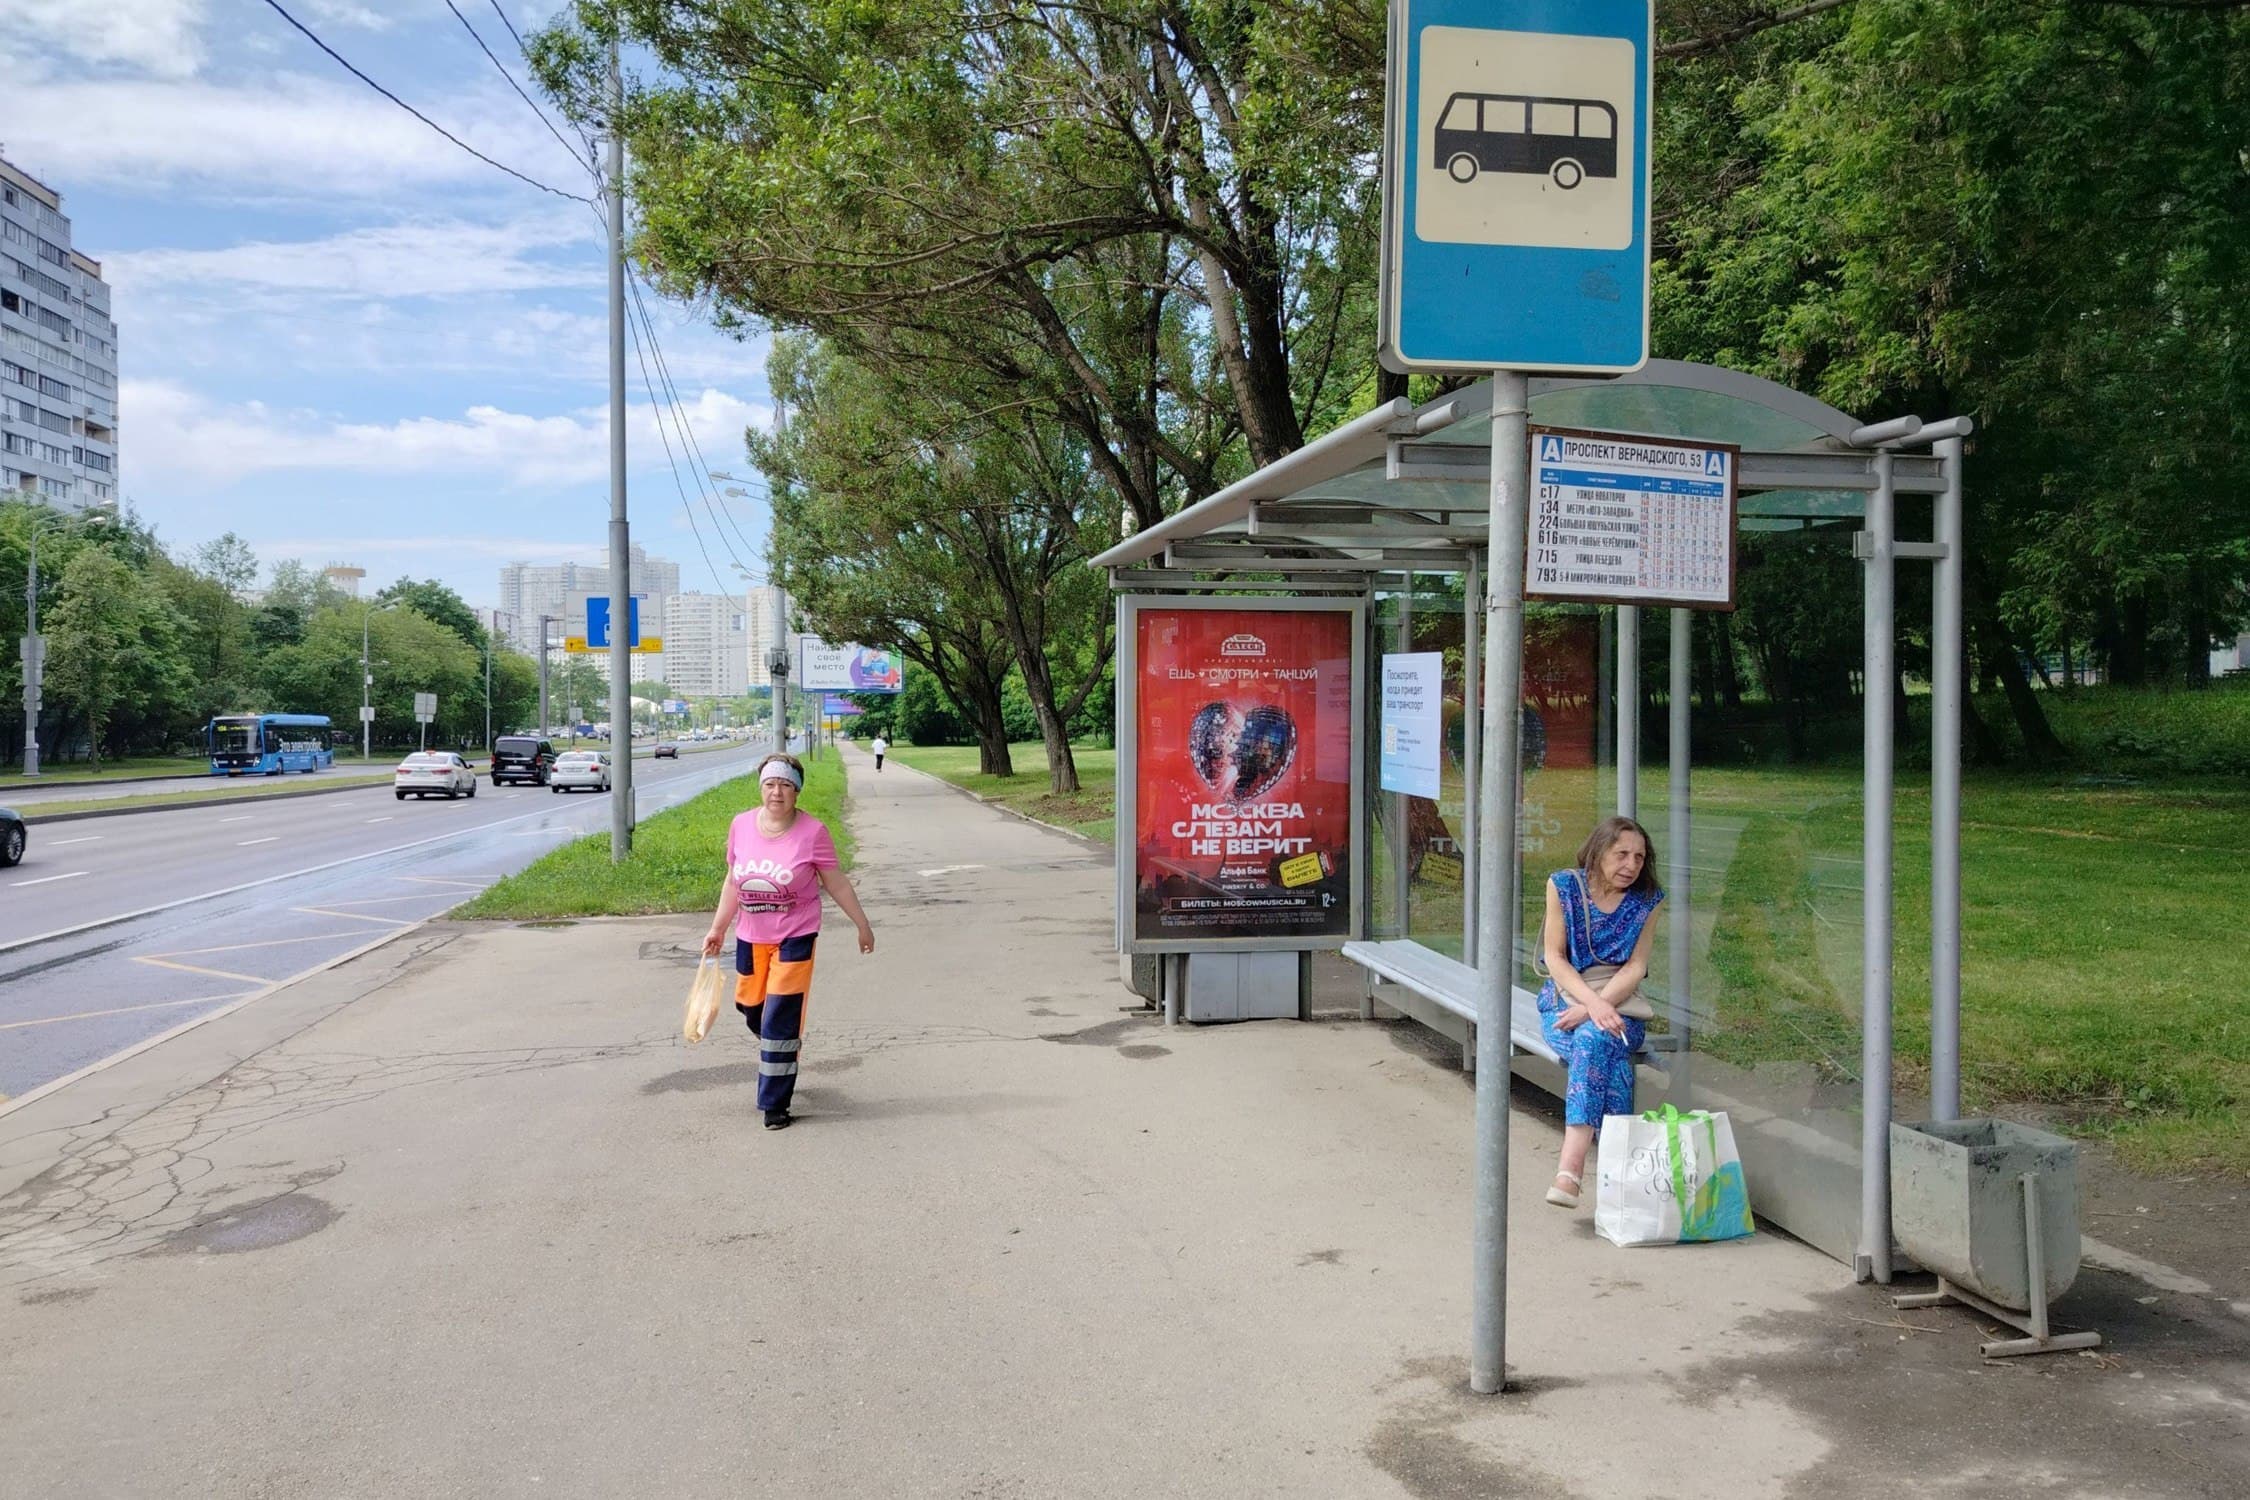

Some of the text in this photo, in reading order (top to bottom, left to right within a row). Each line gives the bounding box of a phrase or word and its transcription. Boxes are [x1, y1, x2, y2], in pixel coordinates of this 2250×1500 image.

[1564, 441, 1616, 459] ПРОСПЕКТ
[1618, 447, 1688, 468] ВЕРНАДСКОГО,
[1690, 453, 1702, 468] 53
[1566, 504, 1585, 515] МЕТРО
[1539, 515, 1559, 530] 224
[1538, 530, 1559, 545] 616
[1559, 534, 1578, 545] МЕТРО
[1537, 549, 1558, 564] 715
[1537, 568, 1557, 583] 793
[1168, 667, 1318, 681] ЕШЬ СМОТРИ ТАНЦУЙ
[279, 738, 291, 753] Это
[1191, 803, 1305, 820] МОСКВА
[1172, 820, 1282, 838] СЛЕЗАМ
[1191, 837, 1312, 856] НЕ ВЕРИТ
[734, 860, 794, 886] RADIO
[1220, 865, 1267, 878] Альфа Банк
[1181, 898, 1307, 909] БИЛЕТЫ: MOSCOWMUSICAL.RU
[1321, 892, 1337, 908] 12+
